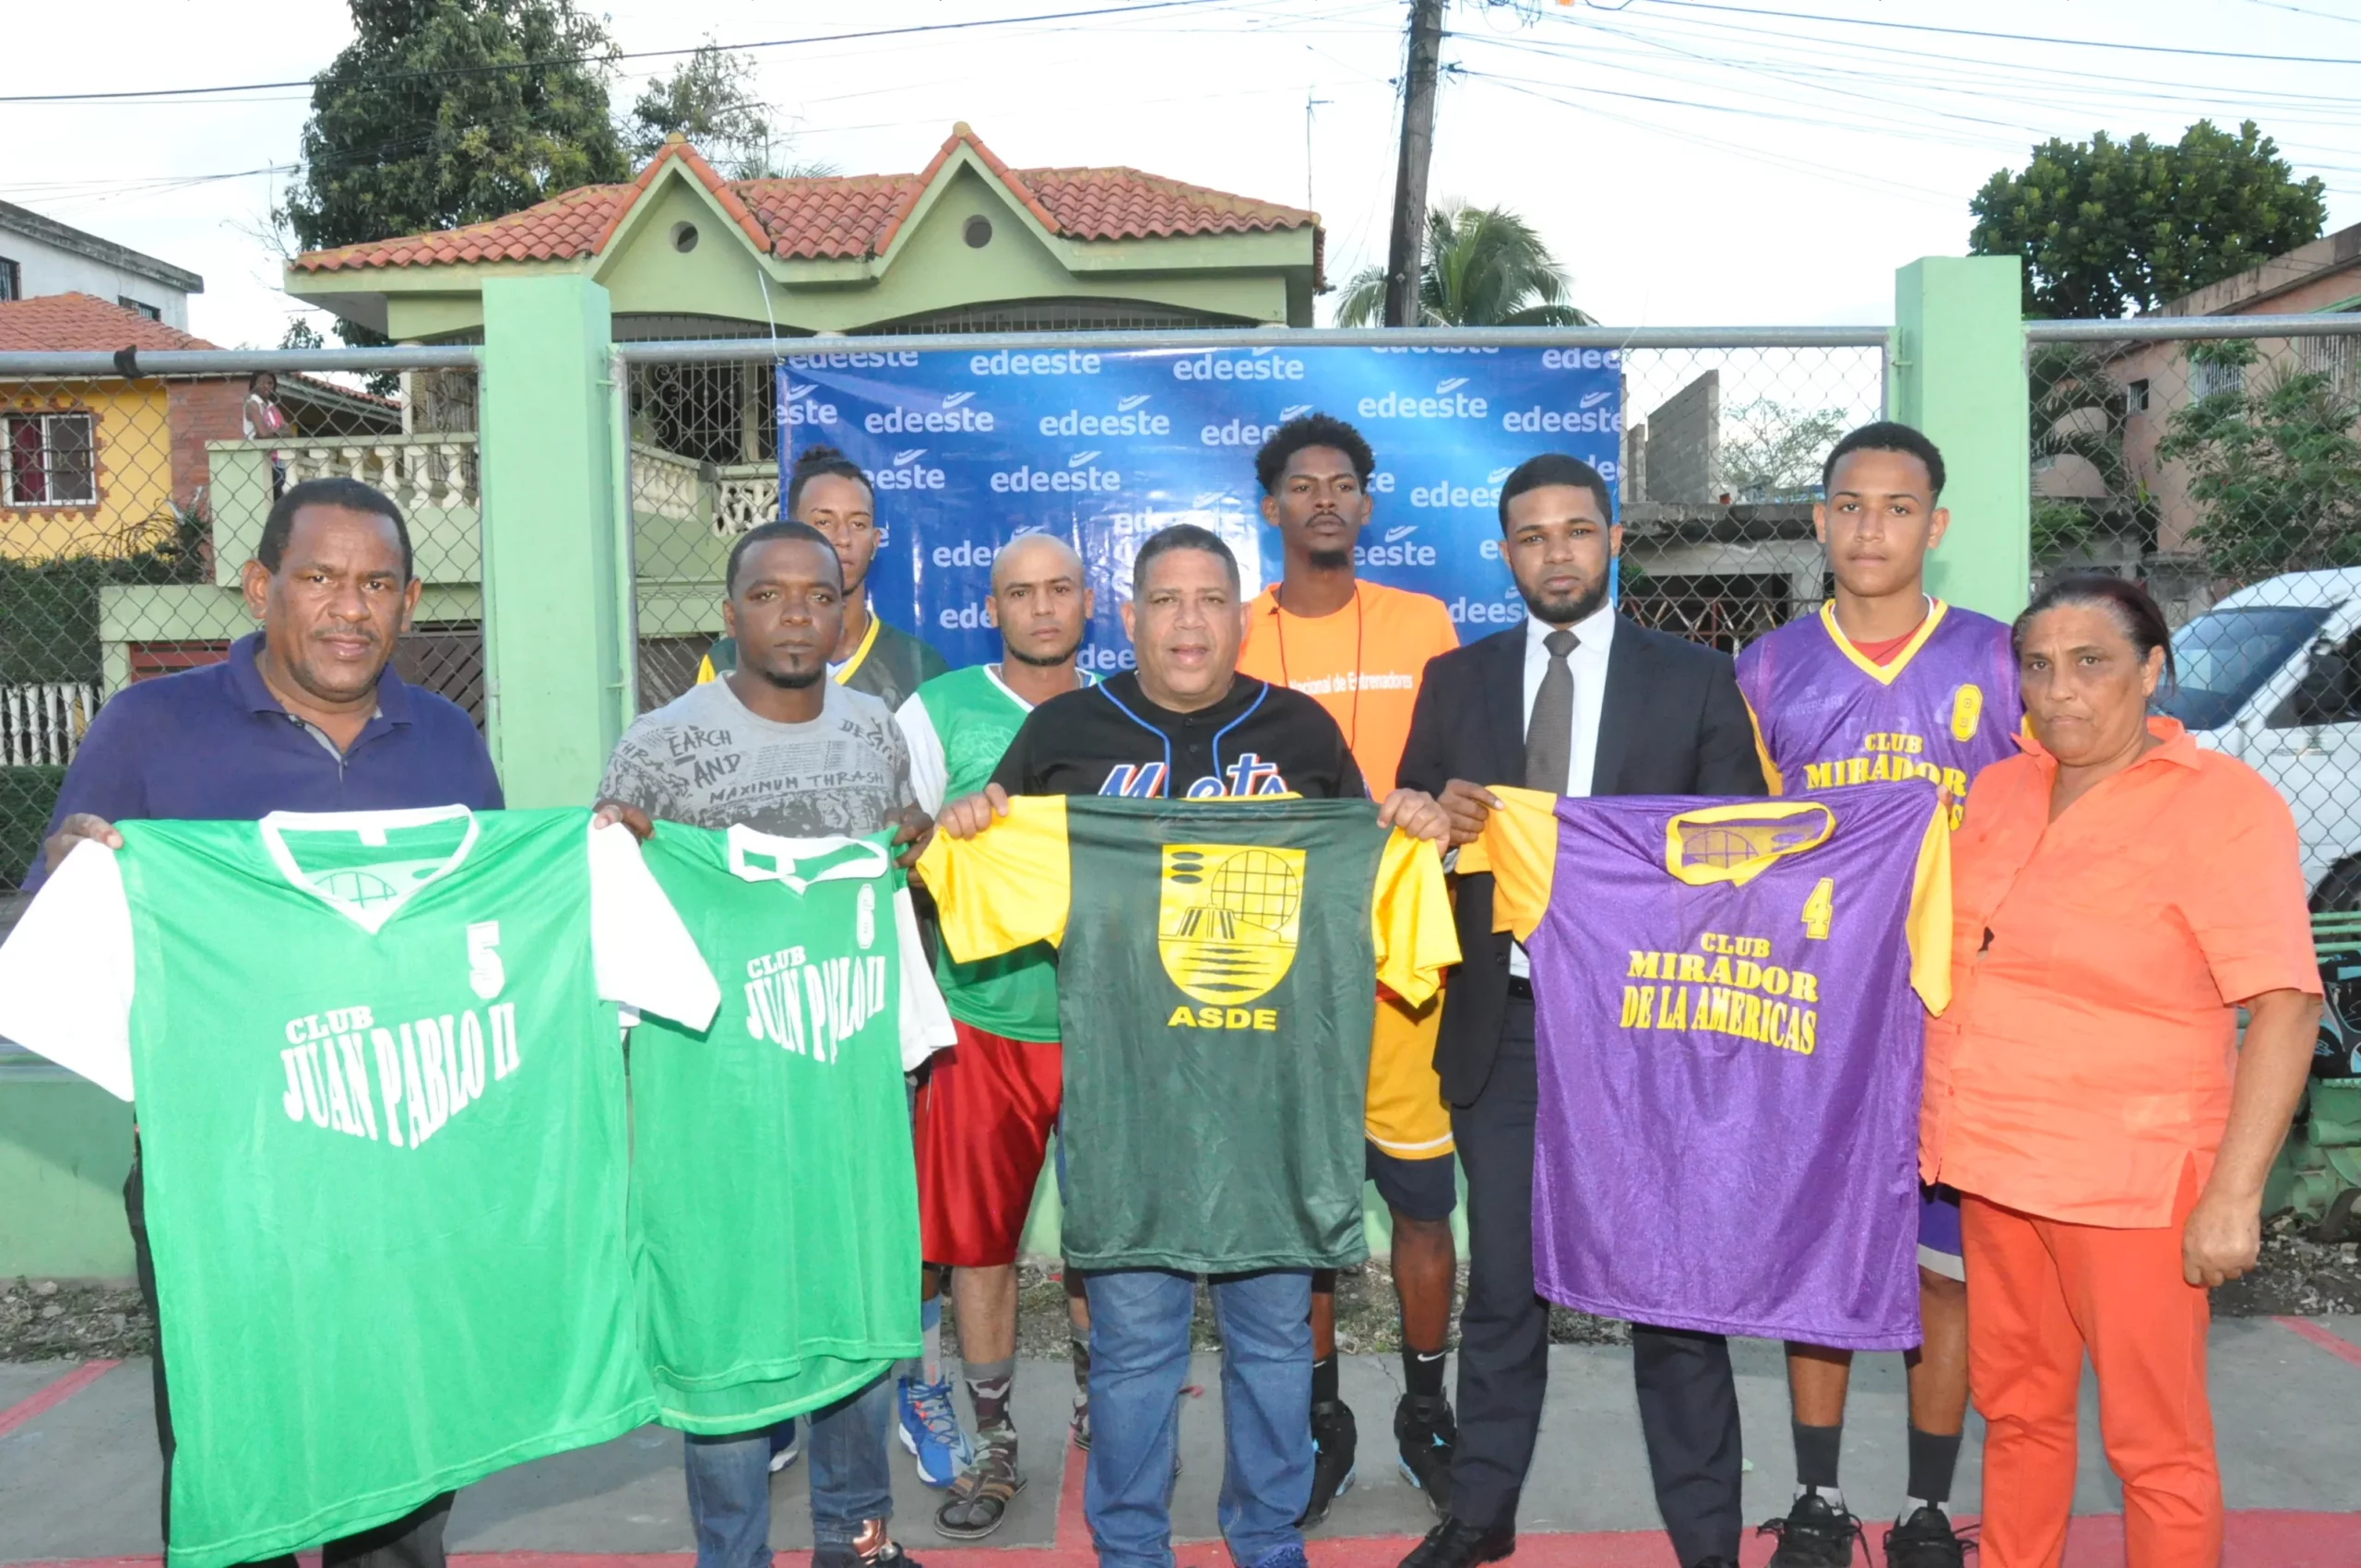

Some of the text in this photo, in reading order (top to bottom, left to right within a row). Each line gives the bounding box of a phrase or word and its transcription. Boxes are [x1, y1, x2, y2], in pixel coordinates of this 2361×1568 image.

[970, 349, 1100, 375] edeeste
[1172, 353, 1304, 380] edeeste
[1542, 347, 1620, 369] edee
[864, 406, 994, 433] edeeste
[1358, 391, 1488, 418] edeeste
[1039, 410, 1169, 436] edeeste
[991, 466, 1121, 493] edeeste
[1410, 481, 1501, 507] edees
[1334, 672, 1347, 693] de
[1347, 670, 1413, 692] Etrenadores
[1951, 683, 1984, 742] 8
[1864, 732, 1924, 754] CLUB
[694, 754, 742, 789] AND
[709, 770, 884, 804] MAXIMUM THRASH
[1803, 754, 1967, 798] MIRADOR
[856, 883, 876, 950] 6
[1801, 877, 1833, 940] 4
[466, 920, 505, 1000] 5
[746, 945, 806, 979] CLUB
[1701, 932, 1771, 958] CLUB
[866, 956, 886, 1019] II
[1627, 950, 1819, 1003] MIRADOR
[285, 1004, 374, 1045] CLUB
[1167, 1005, 1278, 1032] ASDE
[1619, 985, 1818, 1056] DE LA AMERICAS
[279, 1002, 521, 1151] JUAN PABLO II
